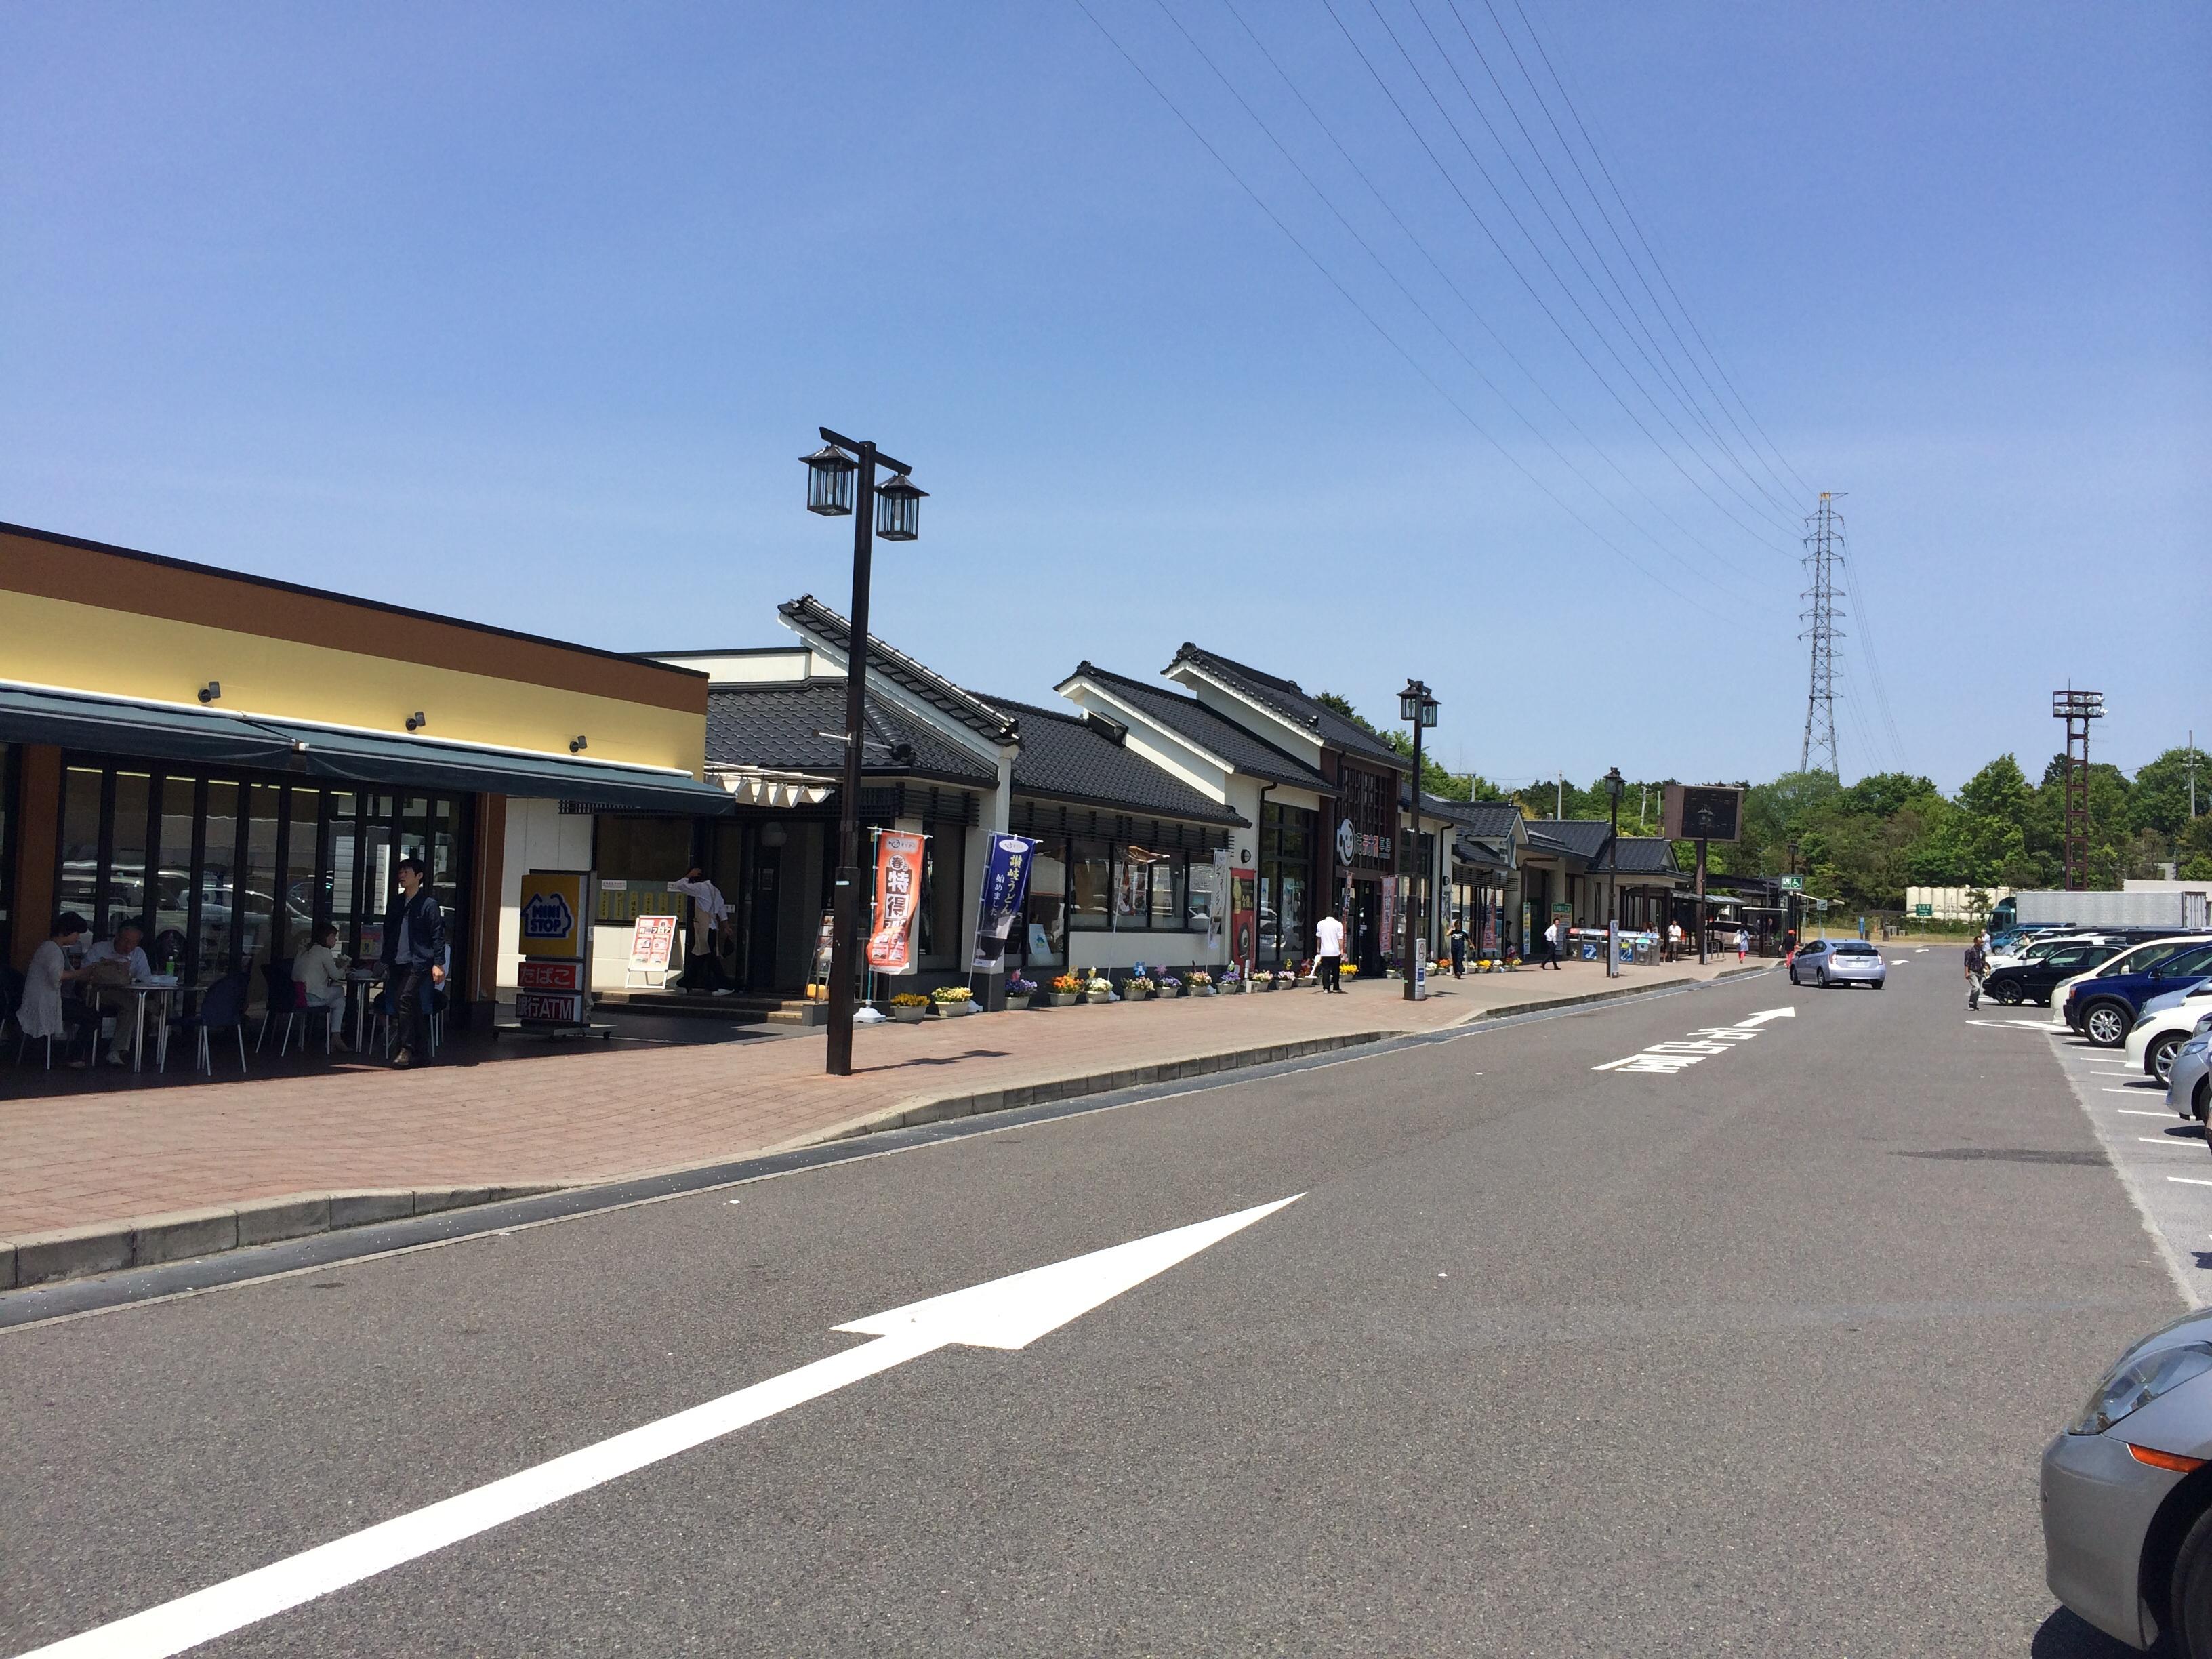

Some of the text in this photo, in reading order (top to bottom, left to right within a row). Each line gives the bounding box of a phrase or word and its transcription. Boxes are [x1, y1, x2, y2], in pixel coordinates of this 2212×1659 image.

[990, 874, 1005, 916] 始めました
[532, 905, 561, 918] MINI
[531, 918, 562, 933] STOP
[520, 966, 570, 985] たばこ
[516, 996, 572, 1020] 銀行ATM
[1591, 1027, 1765, 1073] 名古屋
